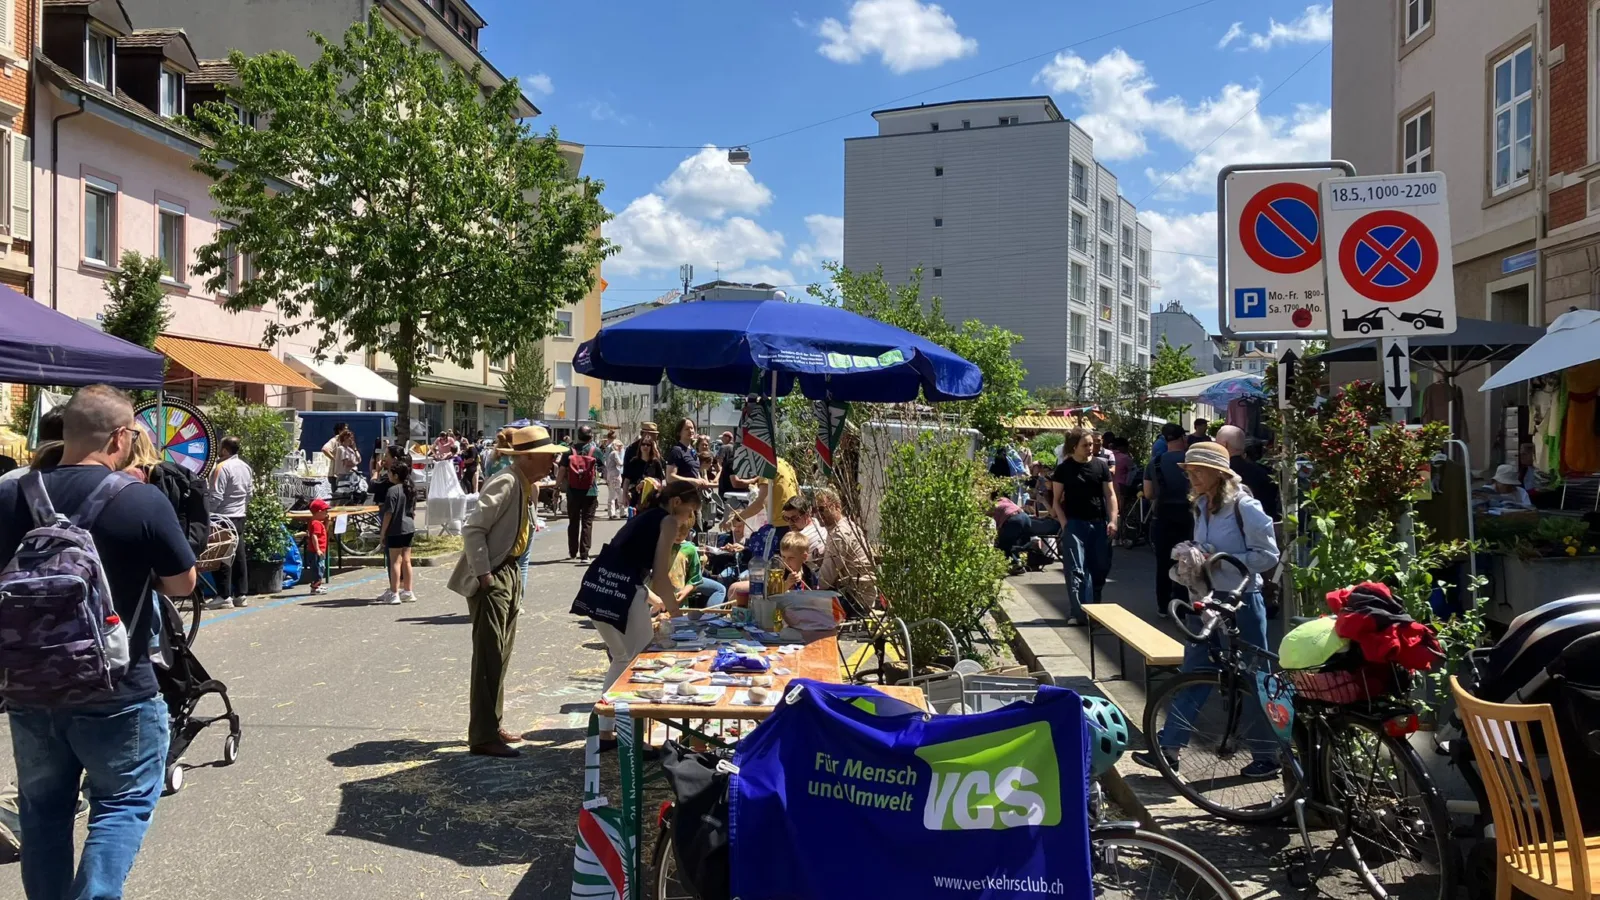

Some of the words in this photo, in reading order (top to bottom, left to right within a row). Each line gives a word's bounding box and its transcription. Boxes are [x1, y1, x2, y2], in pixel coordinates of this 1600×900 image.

[1243, 292, 1258, 314] P
[1268, 304, 1281, 314] Sa.
[815, 752, 840, 775] Für
[842, 758, 917, 786] Mensch
[923, 766, 1046, 830] VCS
[933, 874, 1064, 895] www.verkehrsclub.ch
